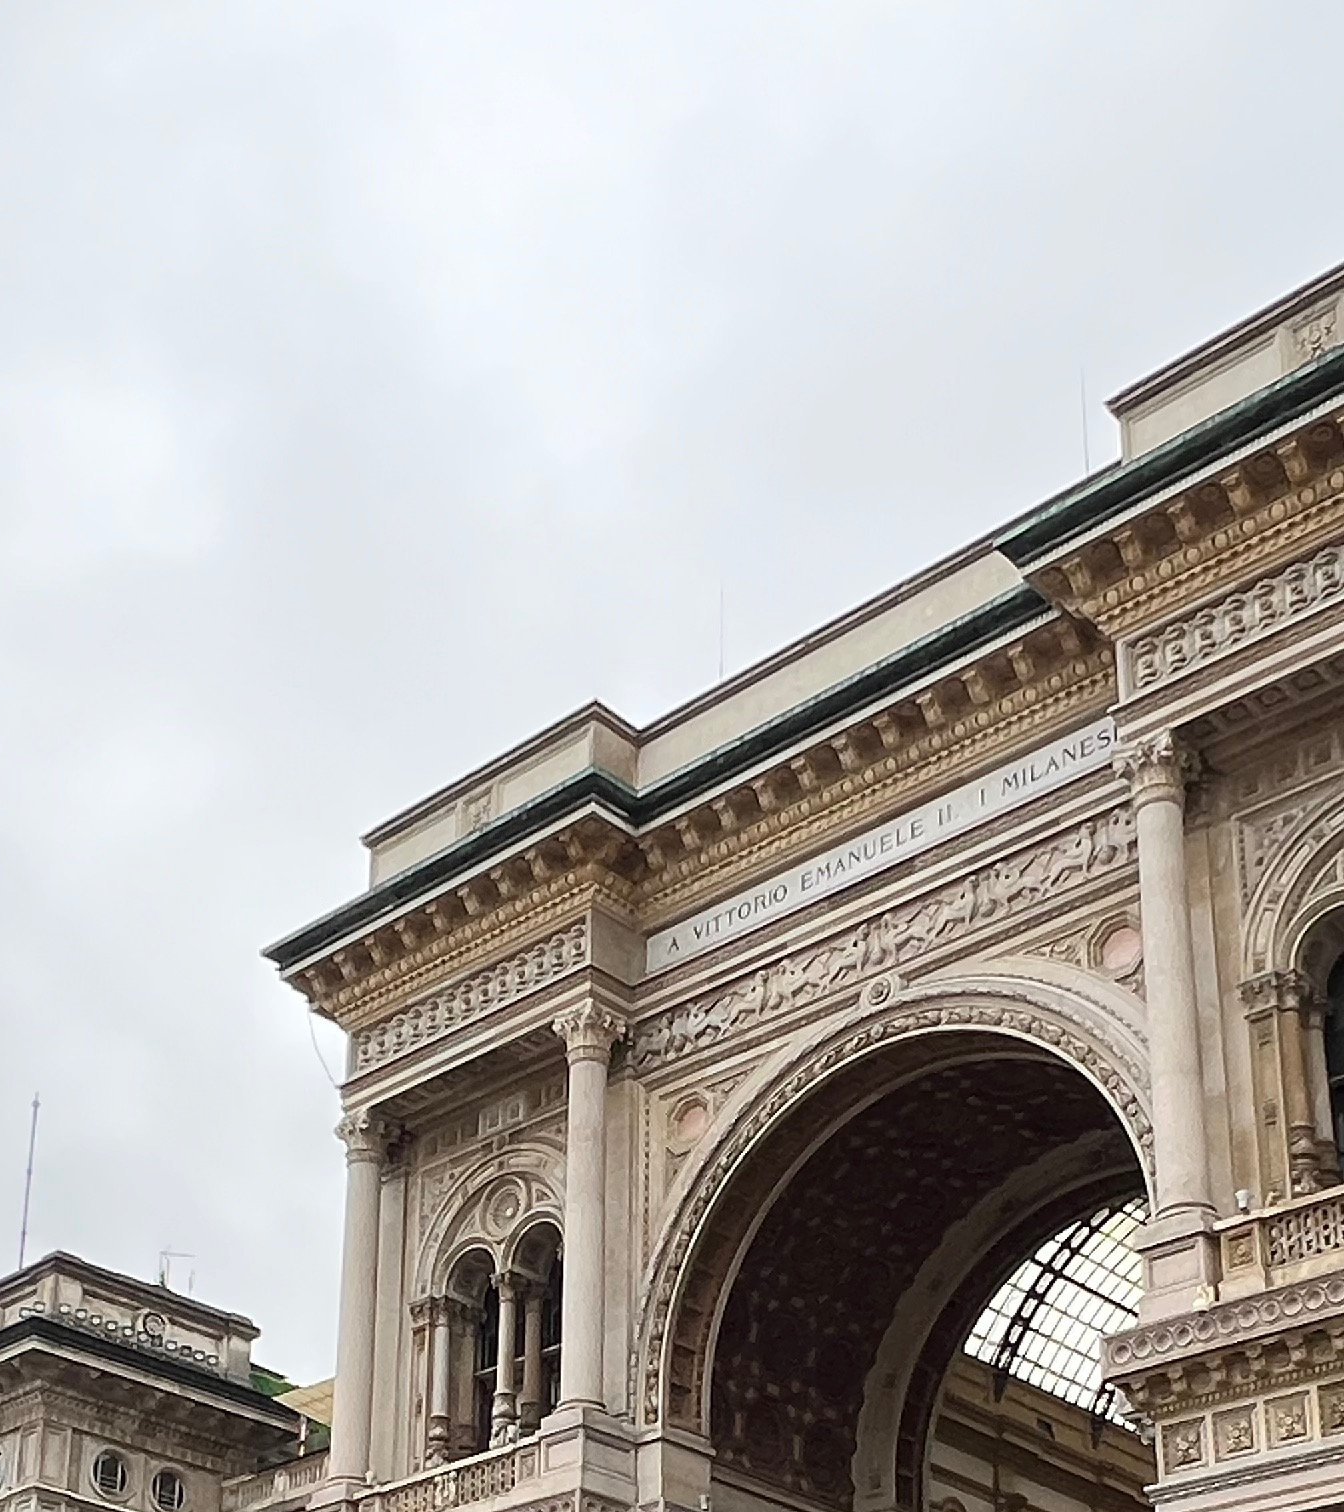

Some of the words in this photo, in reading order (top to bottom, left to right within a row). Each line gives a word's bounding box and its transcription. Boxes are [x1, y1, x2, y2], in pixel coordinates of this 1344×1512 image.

[667, 936, 680, 955] A
[693, 884, 788, 940] VITTORIO
[800, 818, 924, 892] EMANUELE
[1001, 724, 1118, 797] MILANESI
